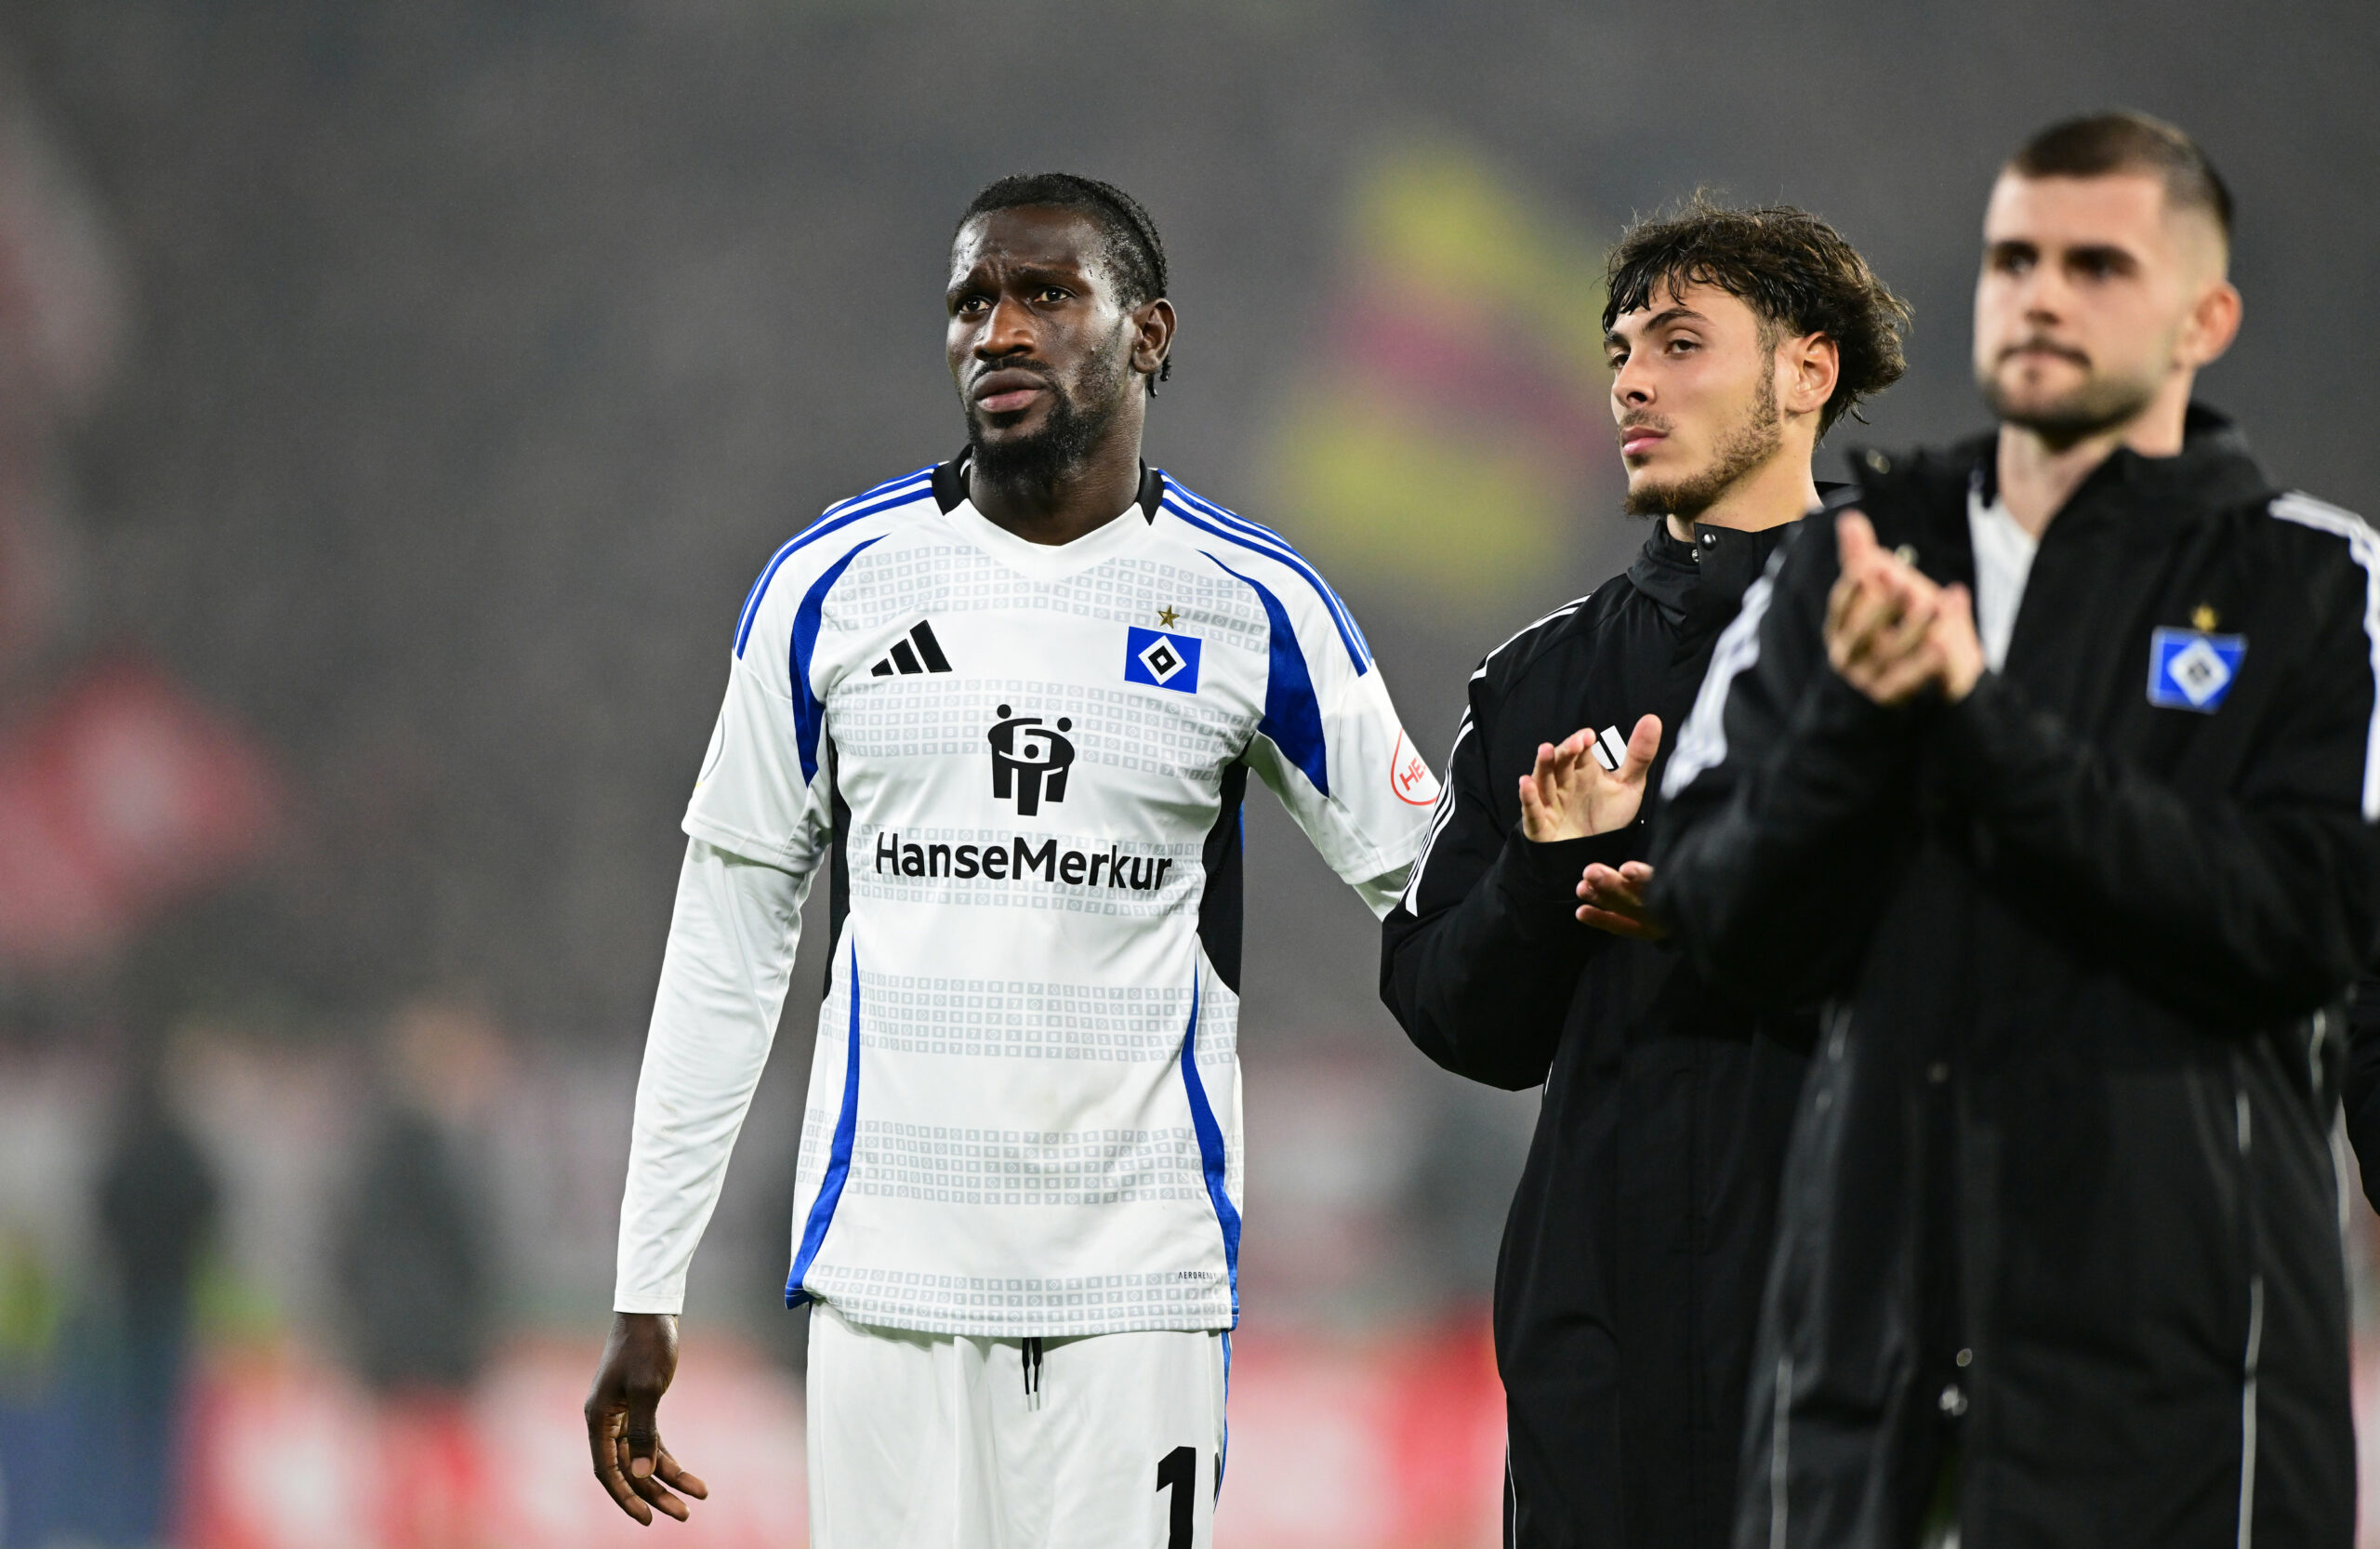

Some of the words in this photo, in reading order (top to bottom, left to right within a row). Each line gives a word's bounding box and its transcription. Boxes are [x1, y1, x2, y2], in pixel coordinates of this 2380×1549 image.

[1399, 757, 1426, 791] HE
[876, 831, 1172, 890] HanseMerkur
[1157, 1446, 1221, 1549] 1
